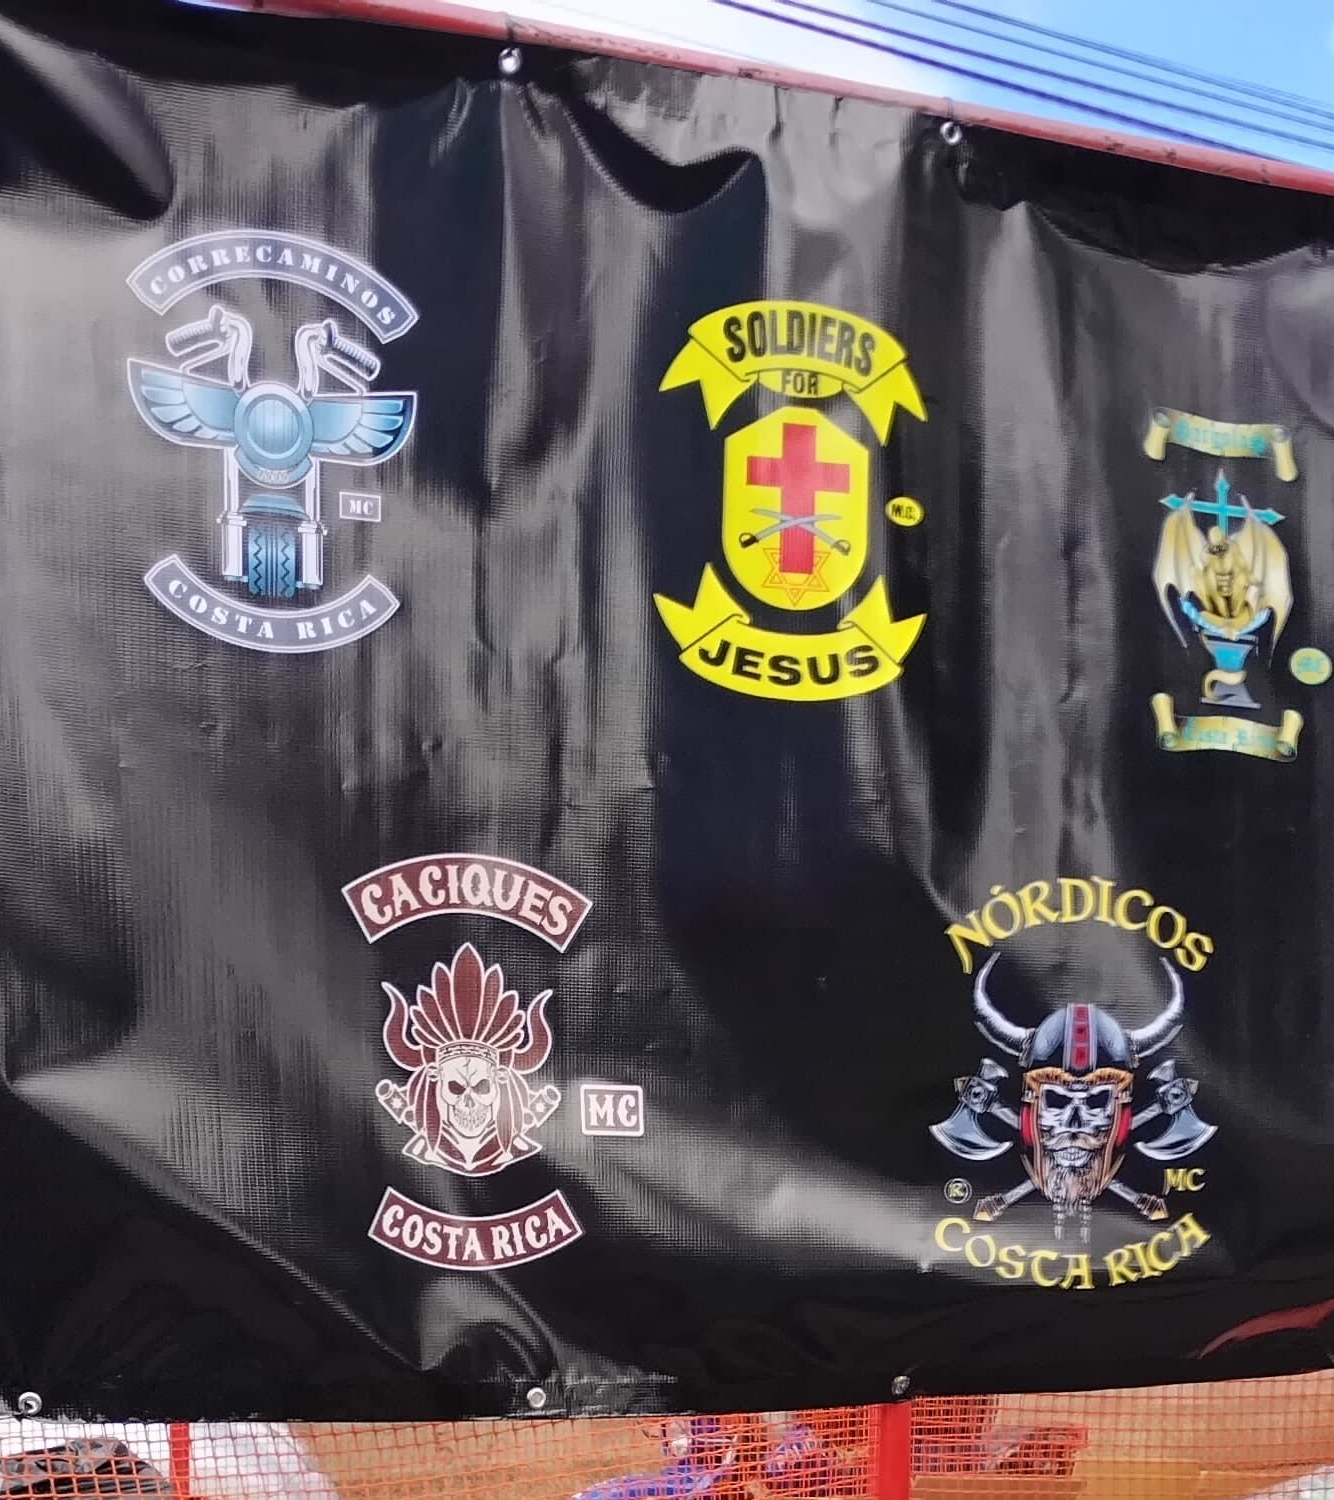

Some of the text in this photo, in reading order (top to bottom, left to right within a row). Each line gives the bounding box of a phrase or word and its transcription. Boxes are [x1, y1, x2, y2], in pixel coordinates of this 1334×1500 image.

[150, 245, 397, 325] CORRECAMINOS
[723, 310, 876, 376] SOLDIERS
[781, 372, 819, 395] FOR
[348, 500, 374, 517] MC
[168, 581, 378, 639] COSTA RICA
[698, 639, 880, 686] JESUS
[361, 864, 573, 936] CACIQUES
[945, 876, 1214, 974] NÓRDICOS
[589, 1094, 637, 1126] MC
[1164, 1168, 1205, 1194] MC
[382, 1204, 572, 1261] COSTA RICA
[935, 1213, 1212, 1289] COSTA RICA
